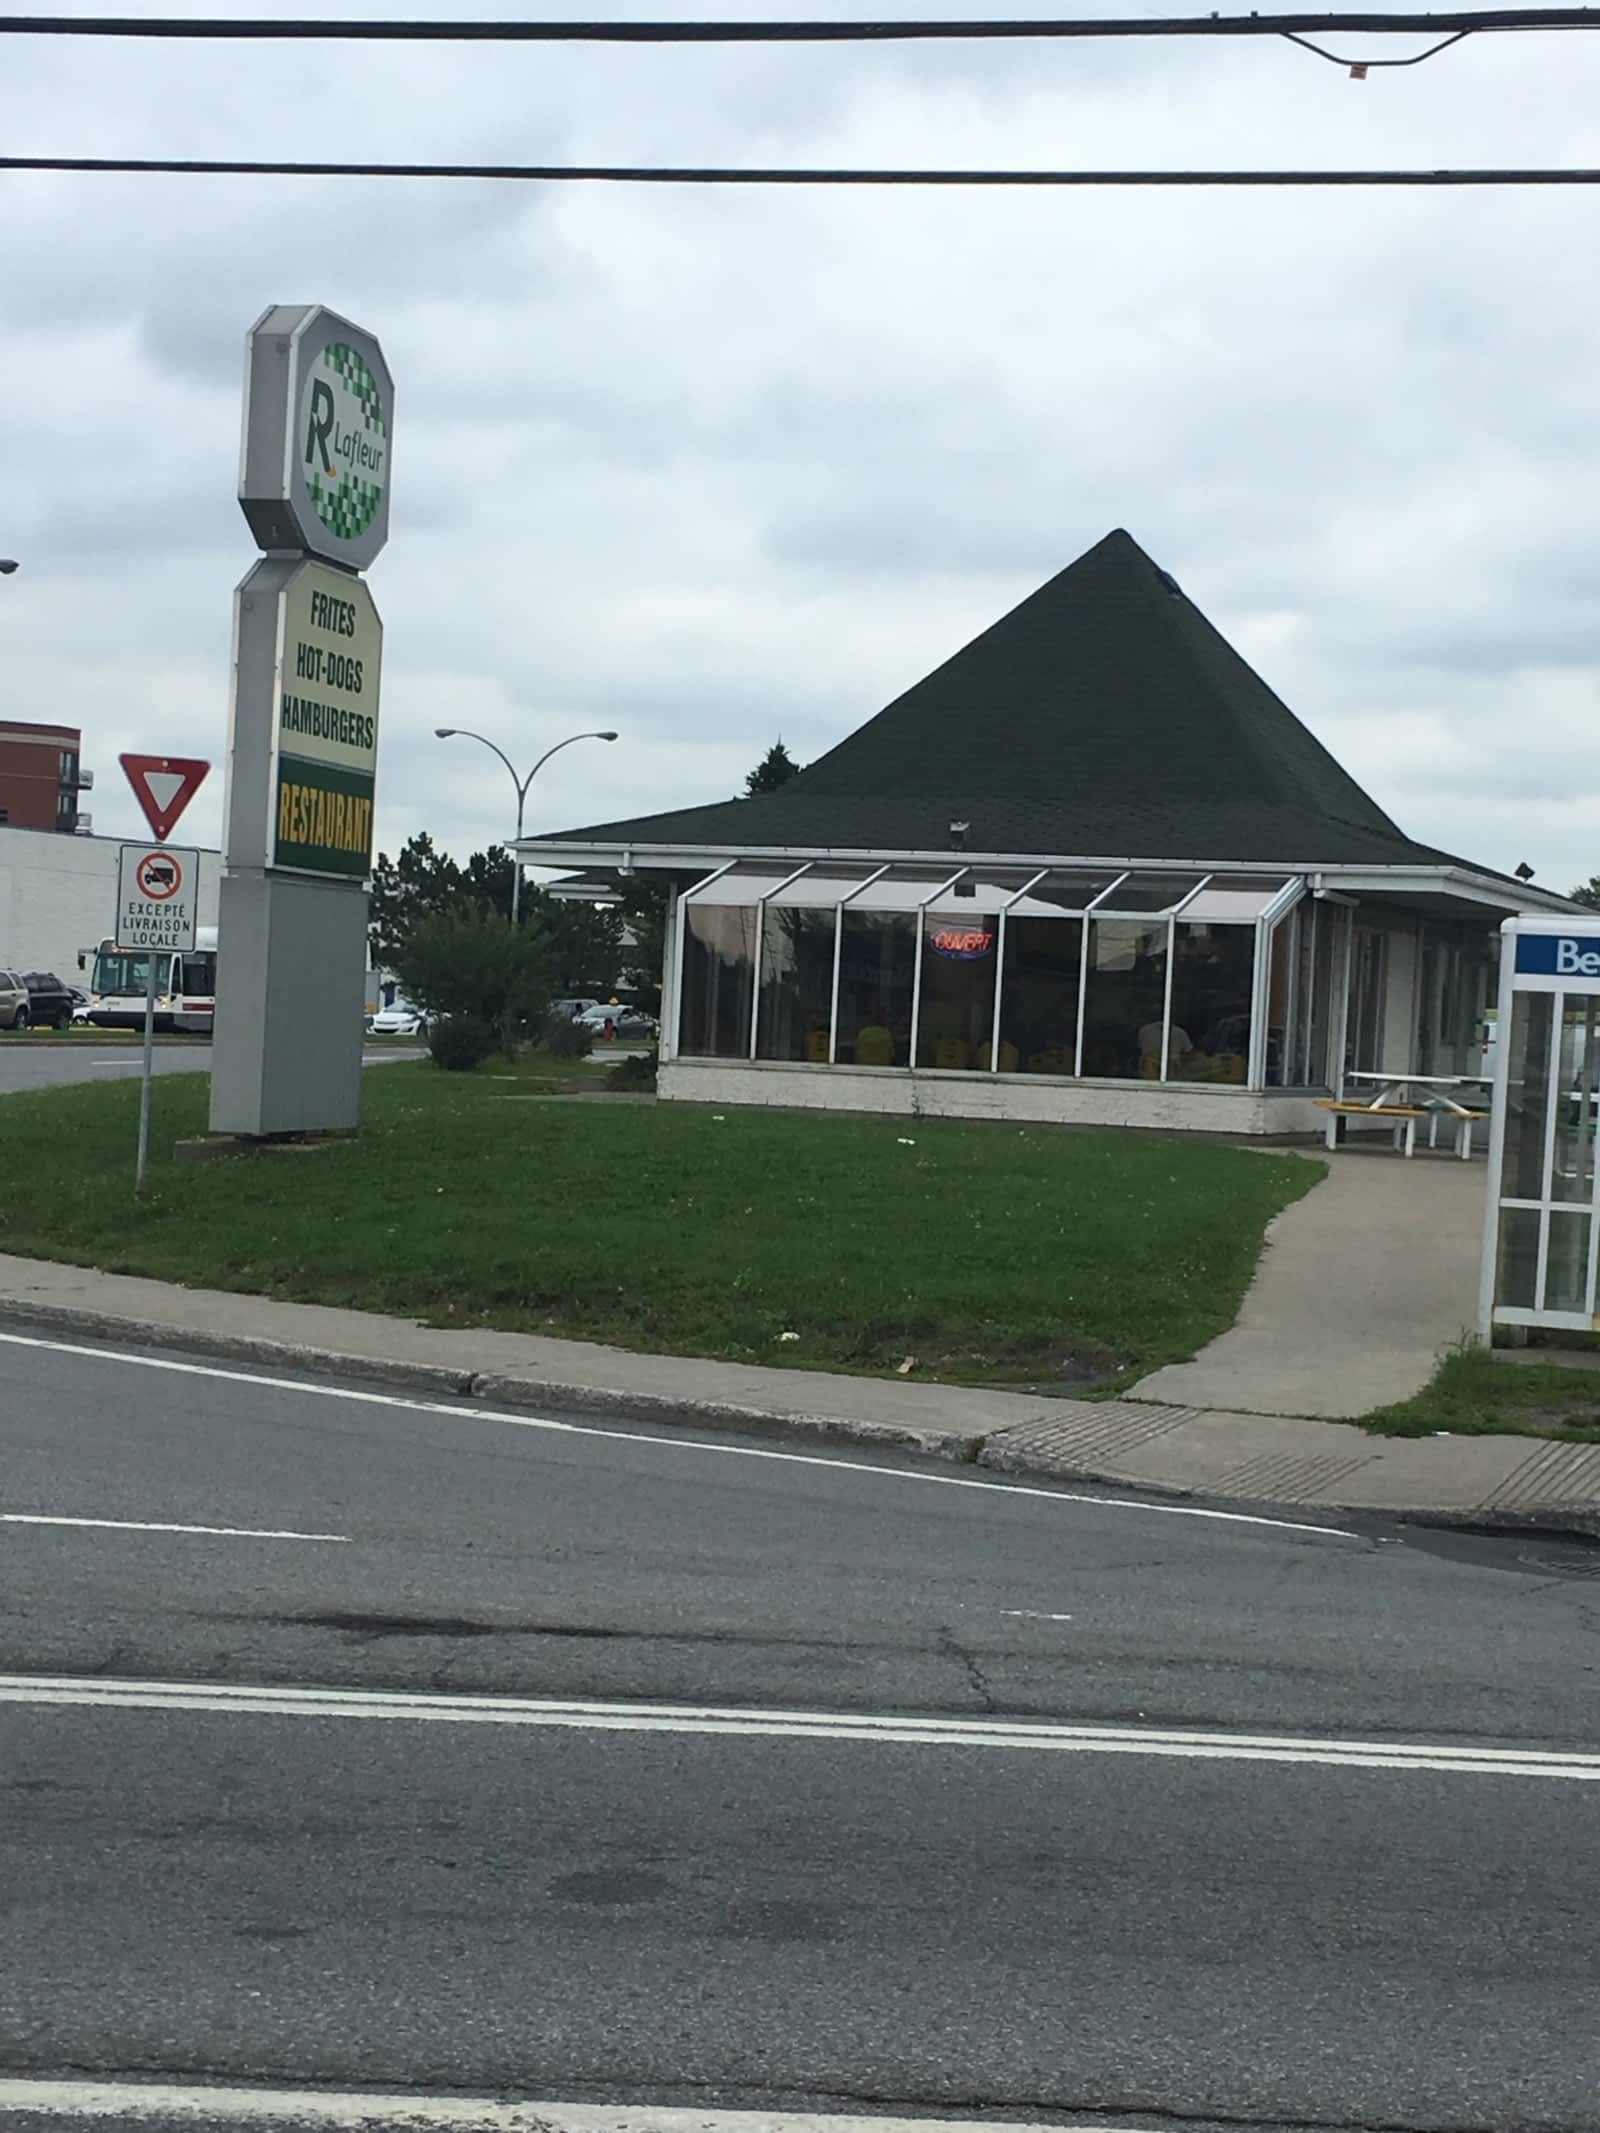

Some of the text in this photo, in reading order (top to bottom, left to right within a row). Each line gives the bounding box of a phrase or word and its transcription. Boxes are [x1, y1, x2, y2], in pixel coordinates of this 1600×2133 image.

[305, 377, 335, 475] R
[334, 422, 383, 472] Lafleur
[310, 590, 356, 638] FRITES
[296, 642, 363, 694] HOT-DOGS
[282, 694, 374, 750] HAMBURGERS
[280, 782, 372, 854] RESTAURANT
[123, 916, 190, 932] LIVRAISON
[128, 902, 185, 918] EXCEPTÉ
[132, 932, 178, 946] LOCALE
[935, 931, 992, 952] OUVERT
